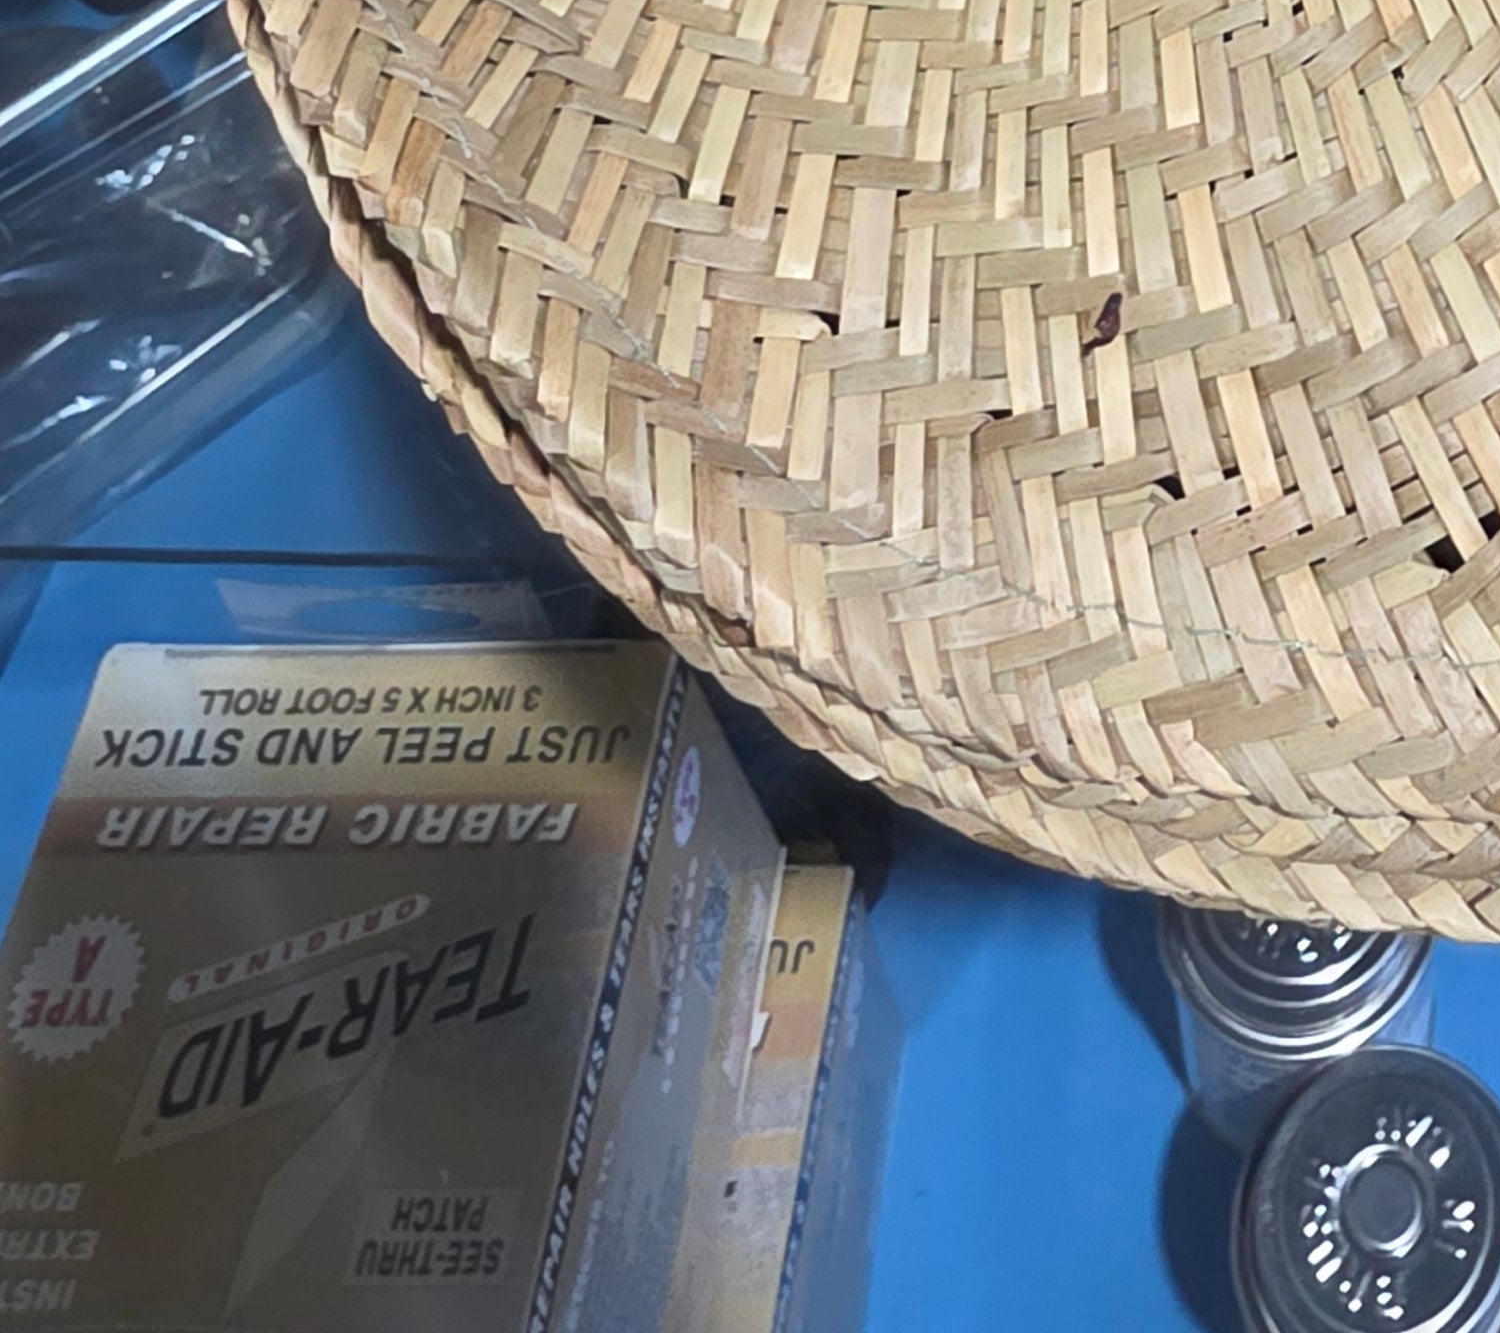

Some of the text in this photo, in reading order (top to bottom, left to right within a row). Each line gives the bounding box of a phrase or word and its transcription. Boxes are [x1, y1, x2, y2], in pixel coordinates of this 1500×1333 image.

[200, 684, 542, 716] 3 INCH X 5 FOOT ROLL
[94, 724, 632, 767] JUST PEEL AND STICK
[96, 802, 579, 848] FABRIC REPAIR
[73, 935, 107, 982] A
[183, 897, 418, 994] ORIGINAL
[20, 988, 113, 1028] TYPE
[159, 913, 537, 1119] TEAR-AID
[0, 1181, 84, 1213] BON
[389, 1195, 488, 1232] PATCH
[0, 1229, 100, 1261] EXTR
[355, 1237, 505, 1277] SEE-THRU
